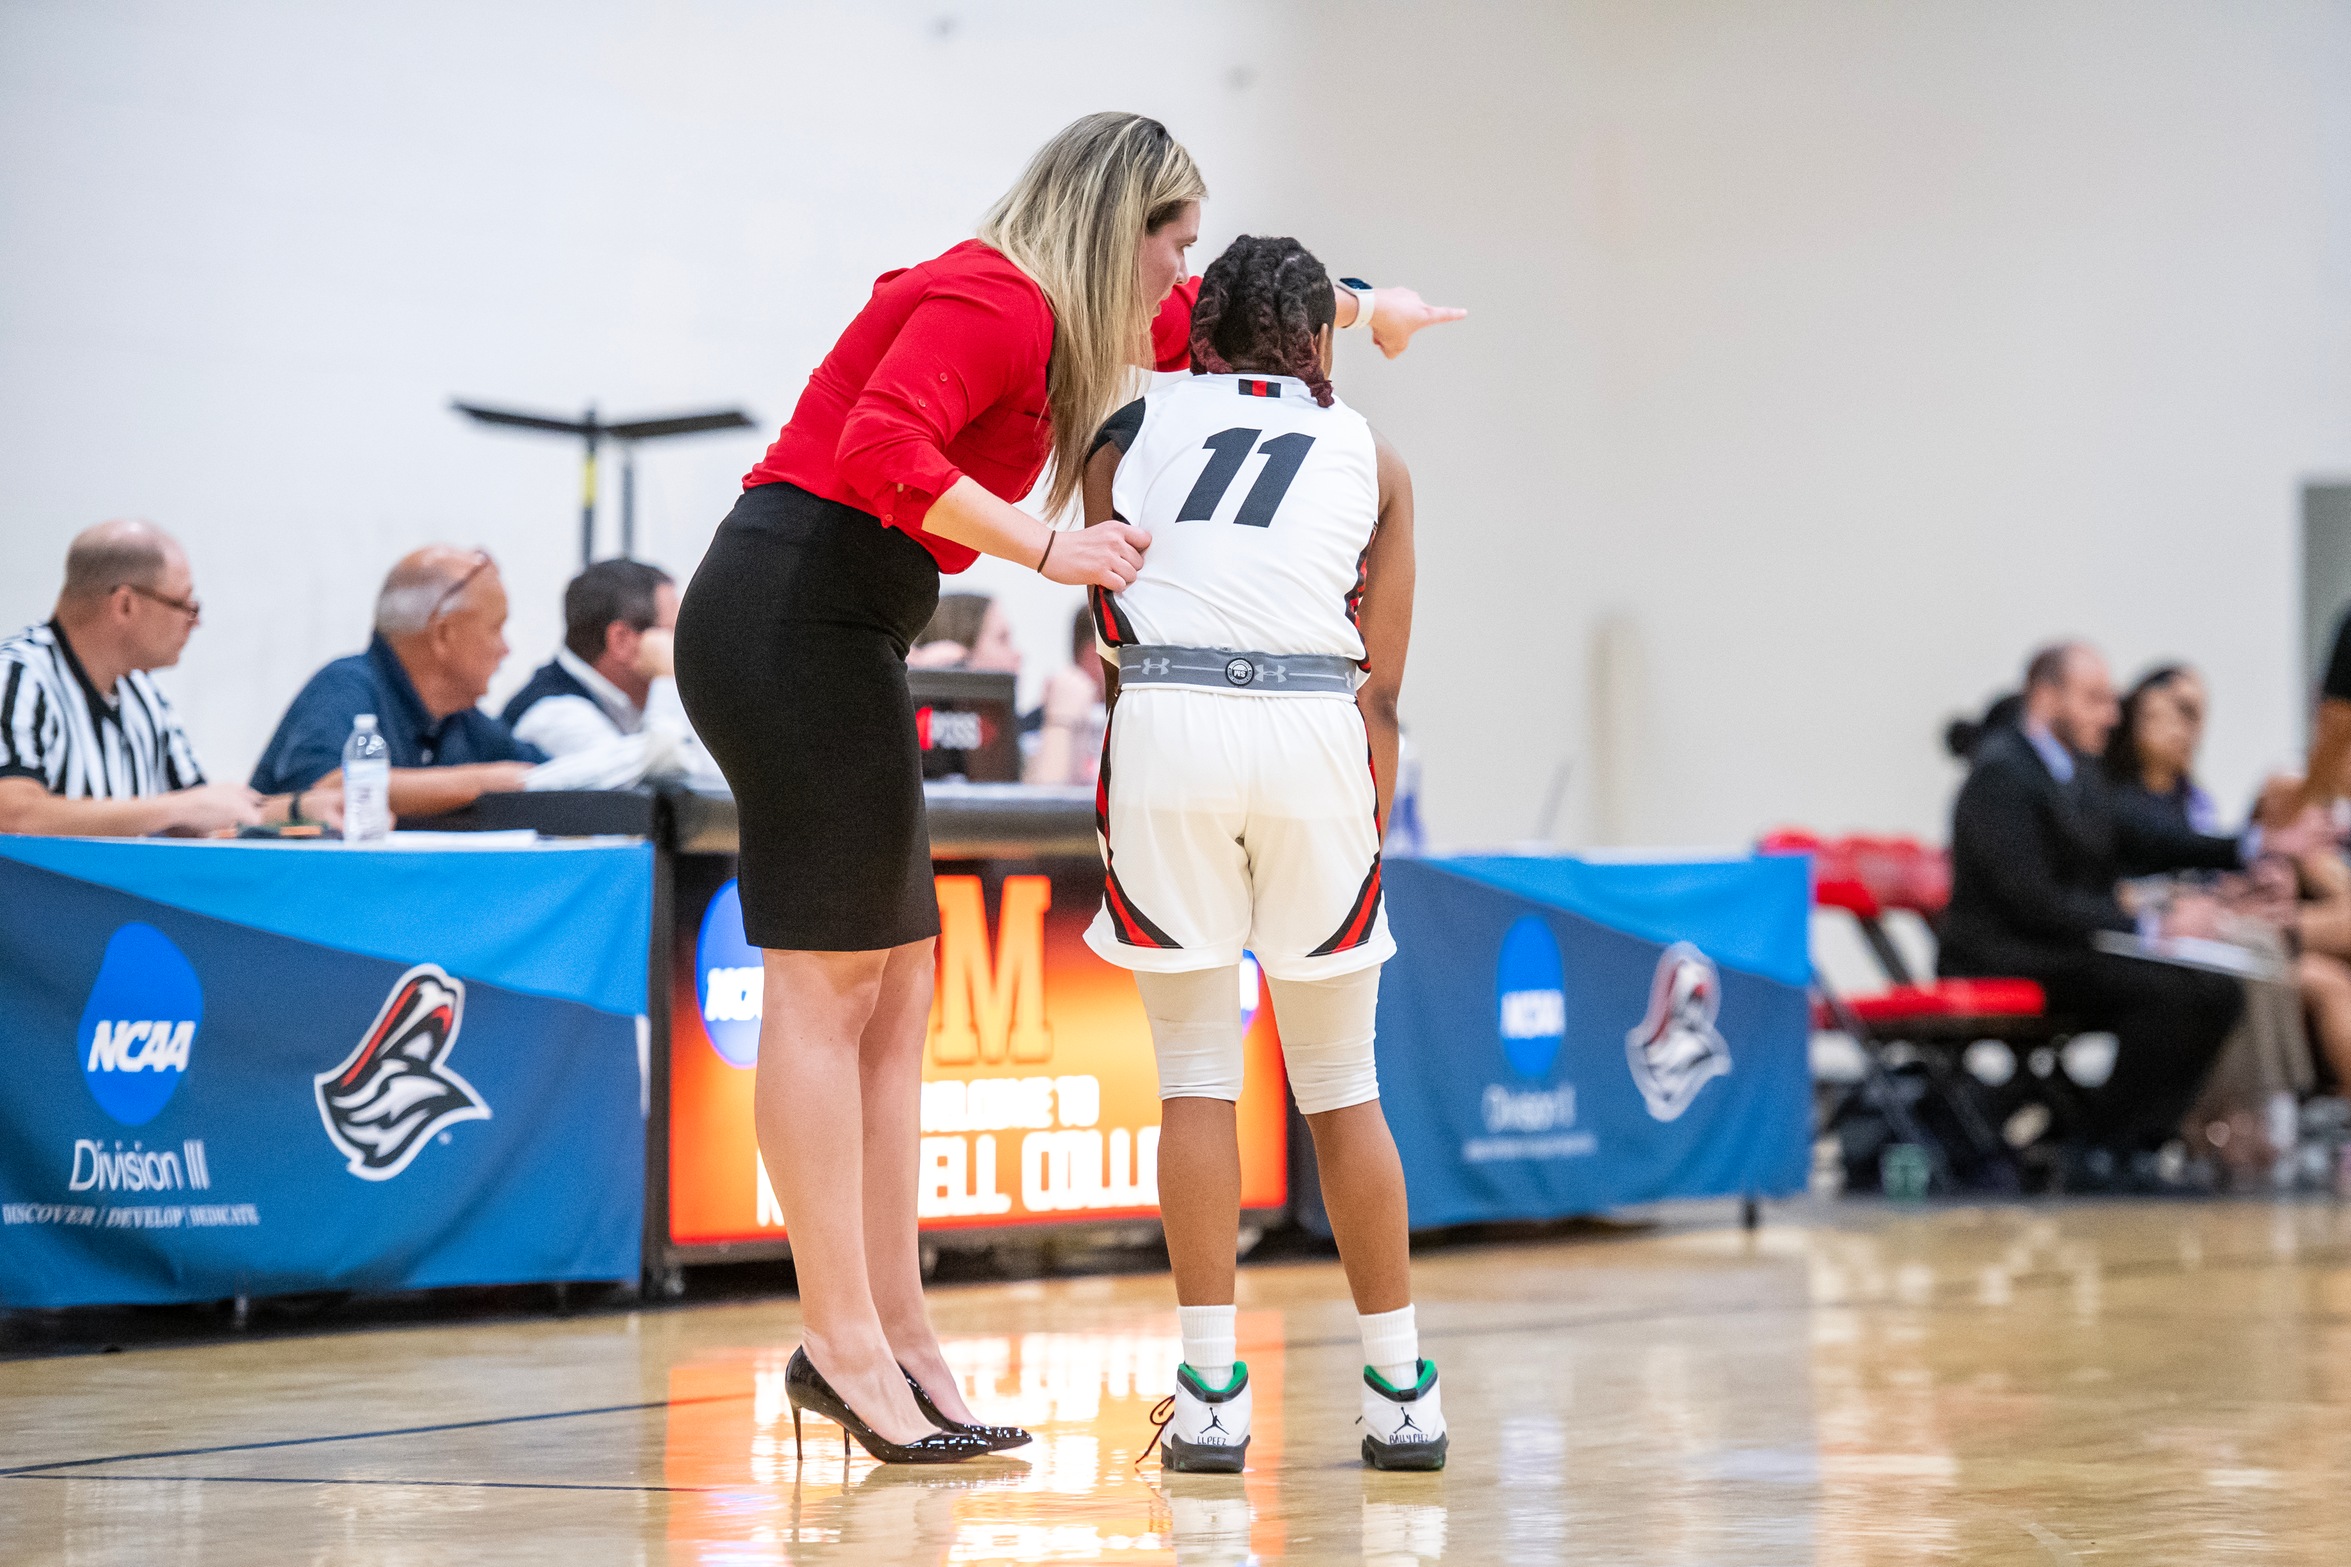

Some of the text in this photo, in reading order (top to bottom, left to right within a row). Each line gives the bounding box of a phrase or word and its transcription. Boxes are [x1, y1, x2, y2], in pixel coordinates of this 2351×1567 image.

[1174, 427, 1316, 528] 11
[930, 874, 1052, 1065] M
[87, 1020, 196, 1072] NCAA
[68, 1138, 211, 1192] Division III
[2, 1203, 97, 1227] DISCOVER
[106, 1205, 183, 1229] DEVELOP
